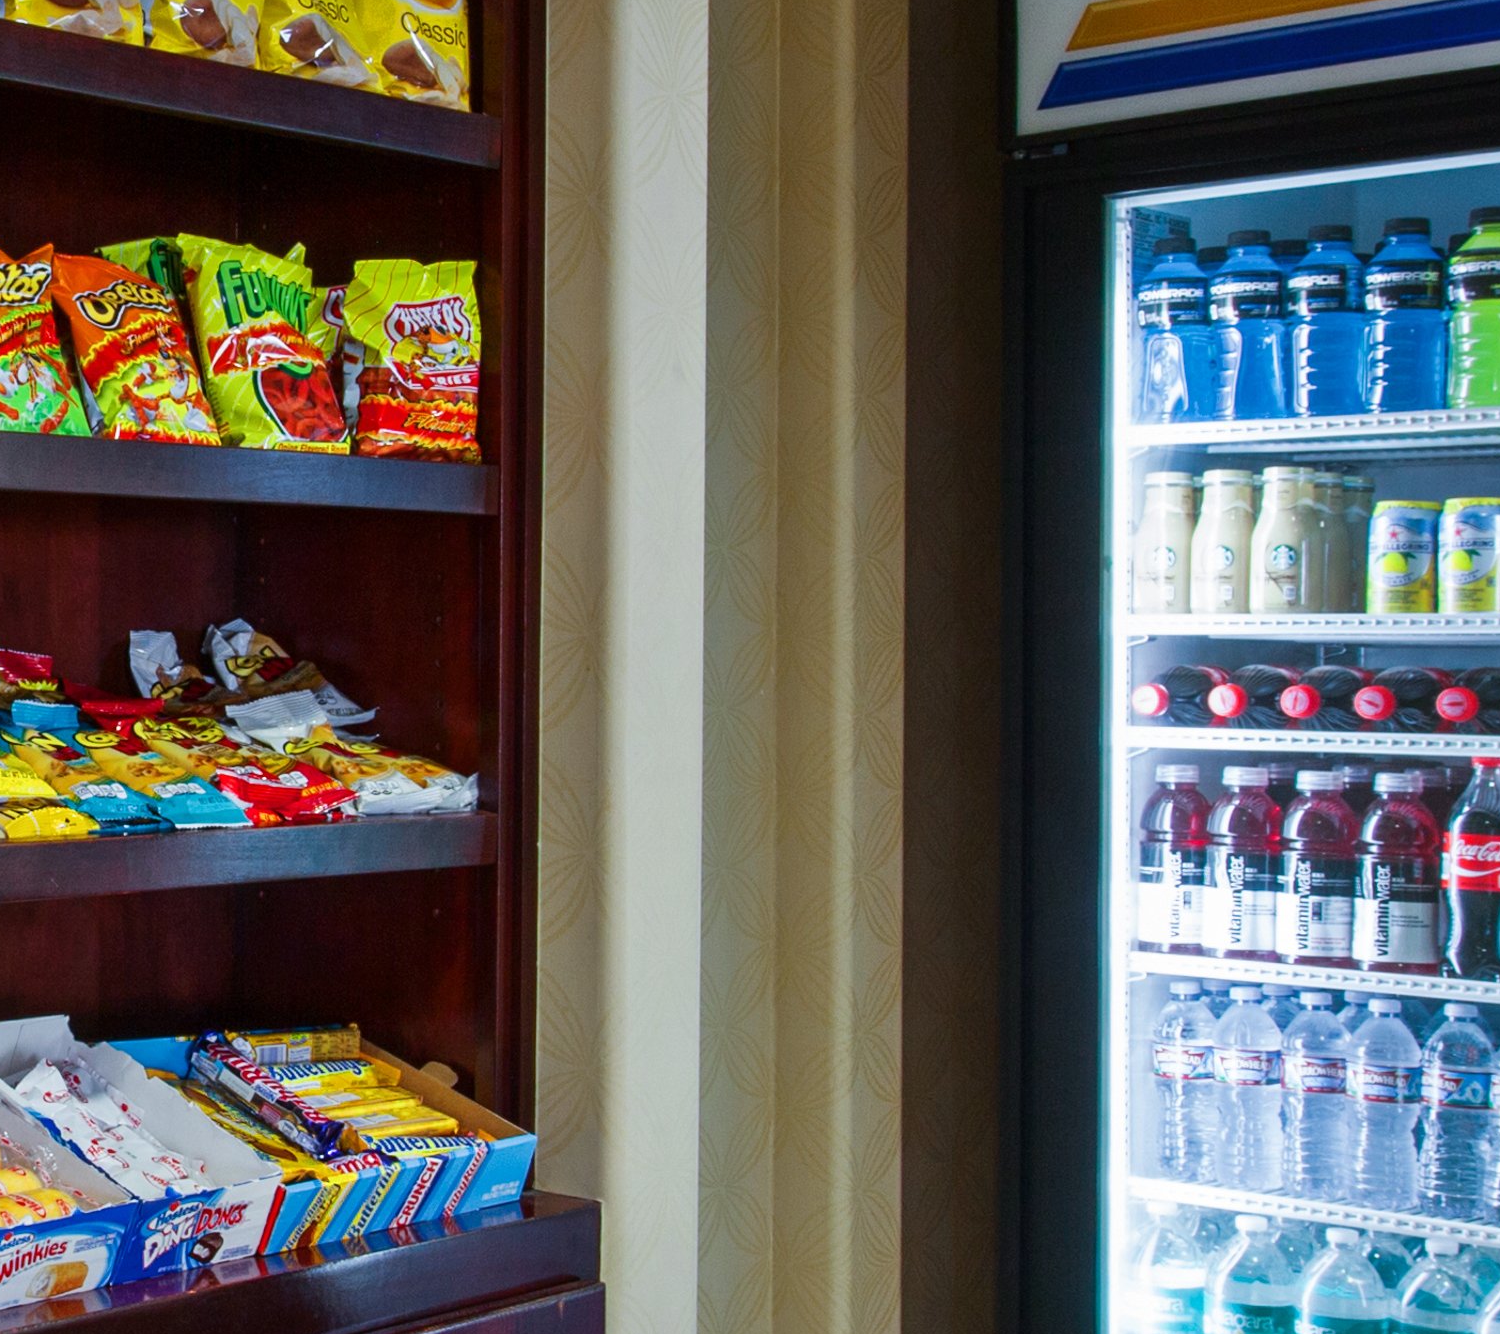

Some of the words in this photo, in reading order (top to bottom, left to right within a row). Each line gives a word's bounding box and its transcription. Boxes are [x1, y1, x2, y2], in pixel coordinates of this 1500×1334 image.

[400, 12, 467, 49] Classic
[1138, 288, 1204, 302] POWERADE
[1209, 281, 1280, 295] POWERADE
[1365, 270, 1441, 285] POWERADE
[1229, 856, 1244, 944] vitaminwater
[1297, 859, 1311, 950] vitaminwater
[1376, 863, 1391, 957] vitaminwater
[395, 1160, 440, 1227] CRUNCH
[156, 1202, 203, 1228] Hostess
